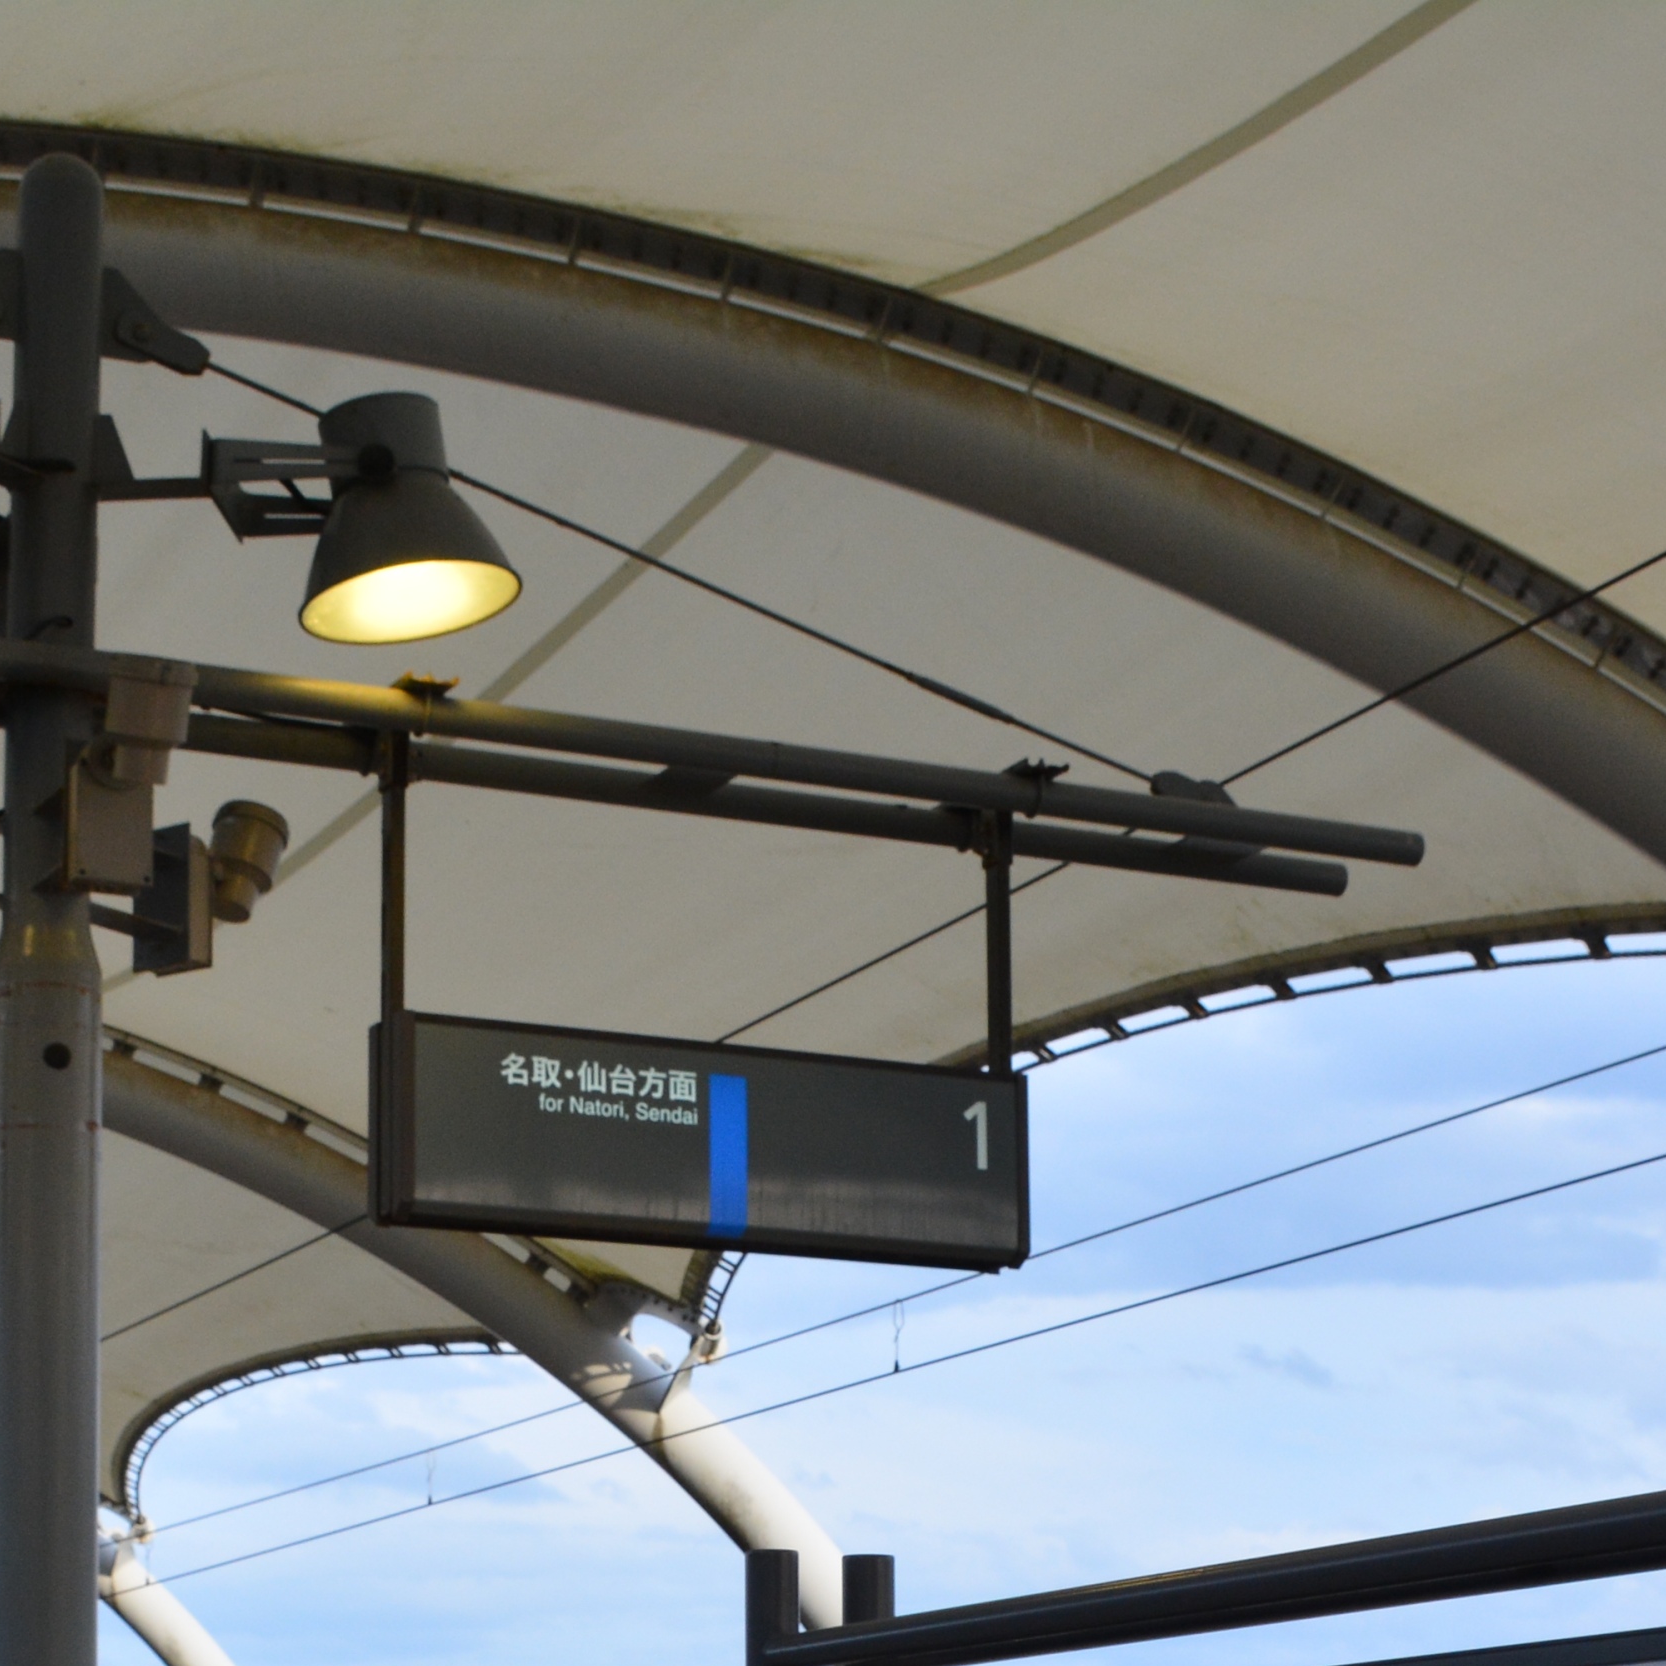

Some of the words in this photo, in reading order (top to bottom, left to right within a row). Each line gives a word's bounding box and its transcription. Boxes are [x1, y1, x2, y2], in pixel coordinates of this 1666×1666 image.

[499, 1051, 698, 1103] 名取・仙台方面
[538, 1092, 565, 1113] for
[568, 1095, 631, 1121] Natori,
[635, 1102, 699, 1126] Sendai
[962, 1100, 989, 1171] 1
